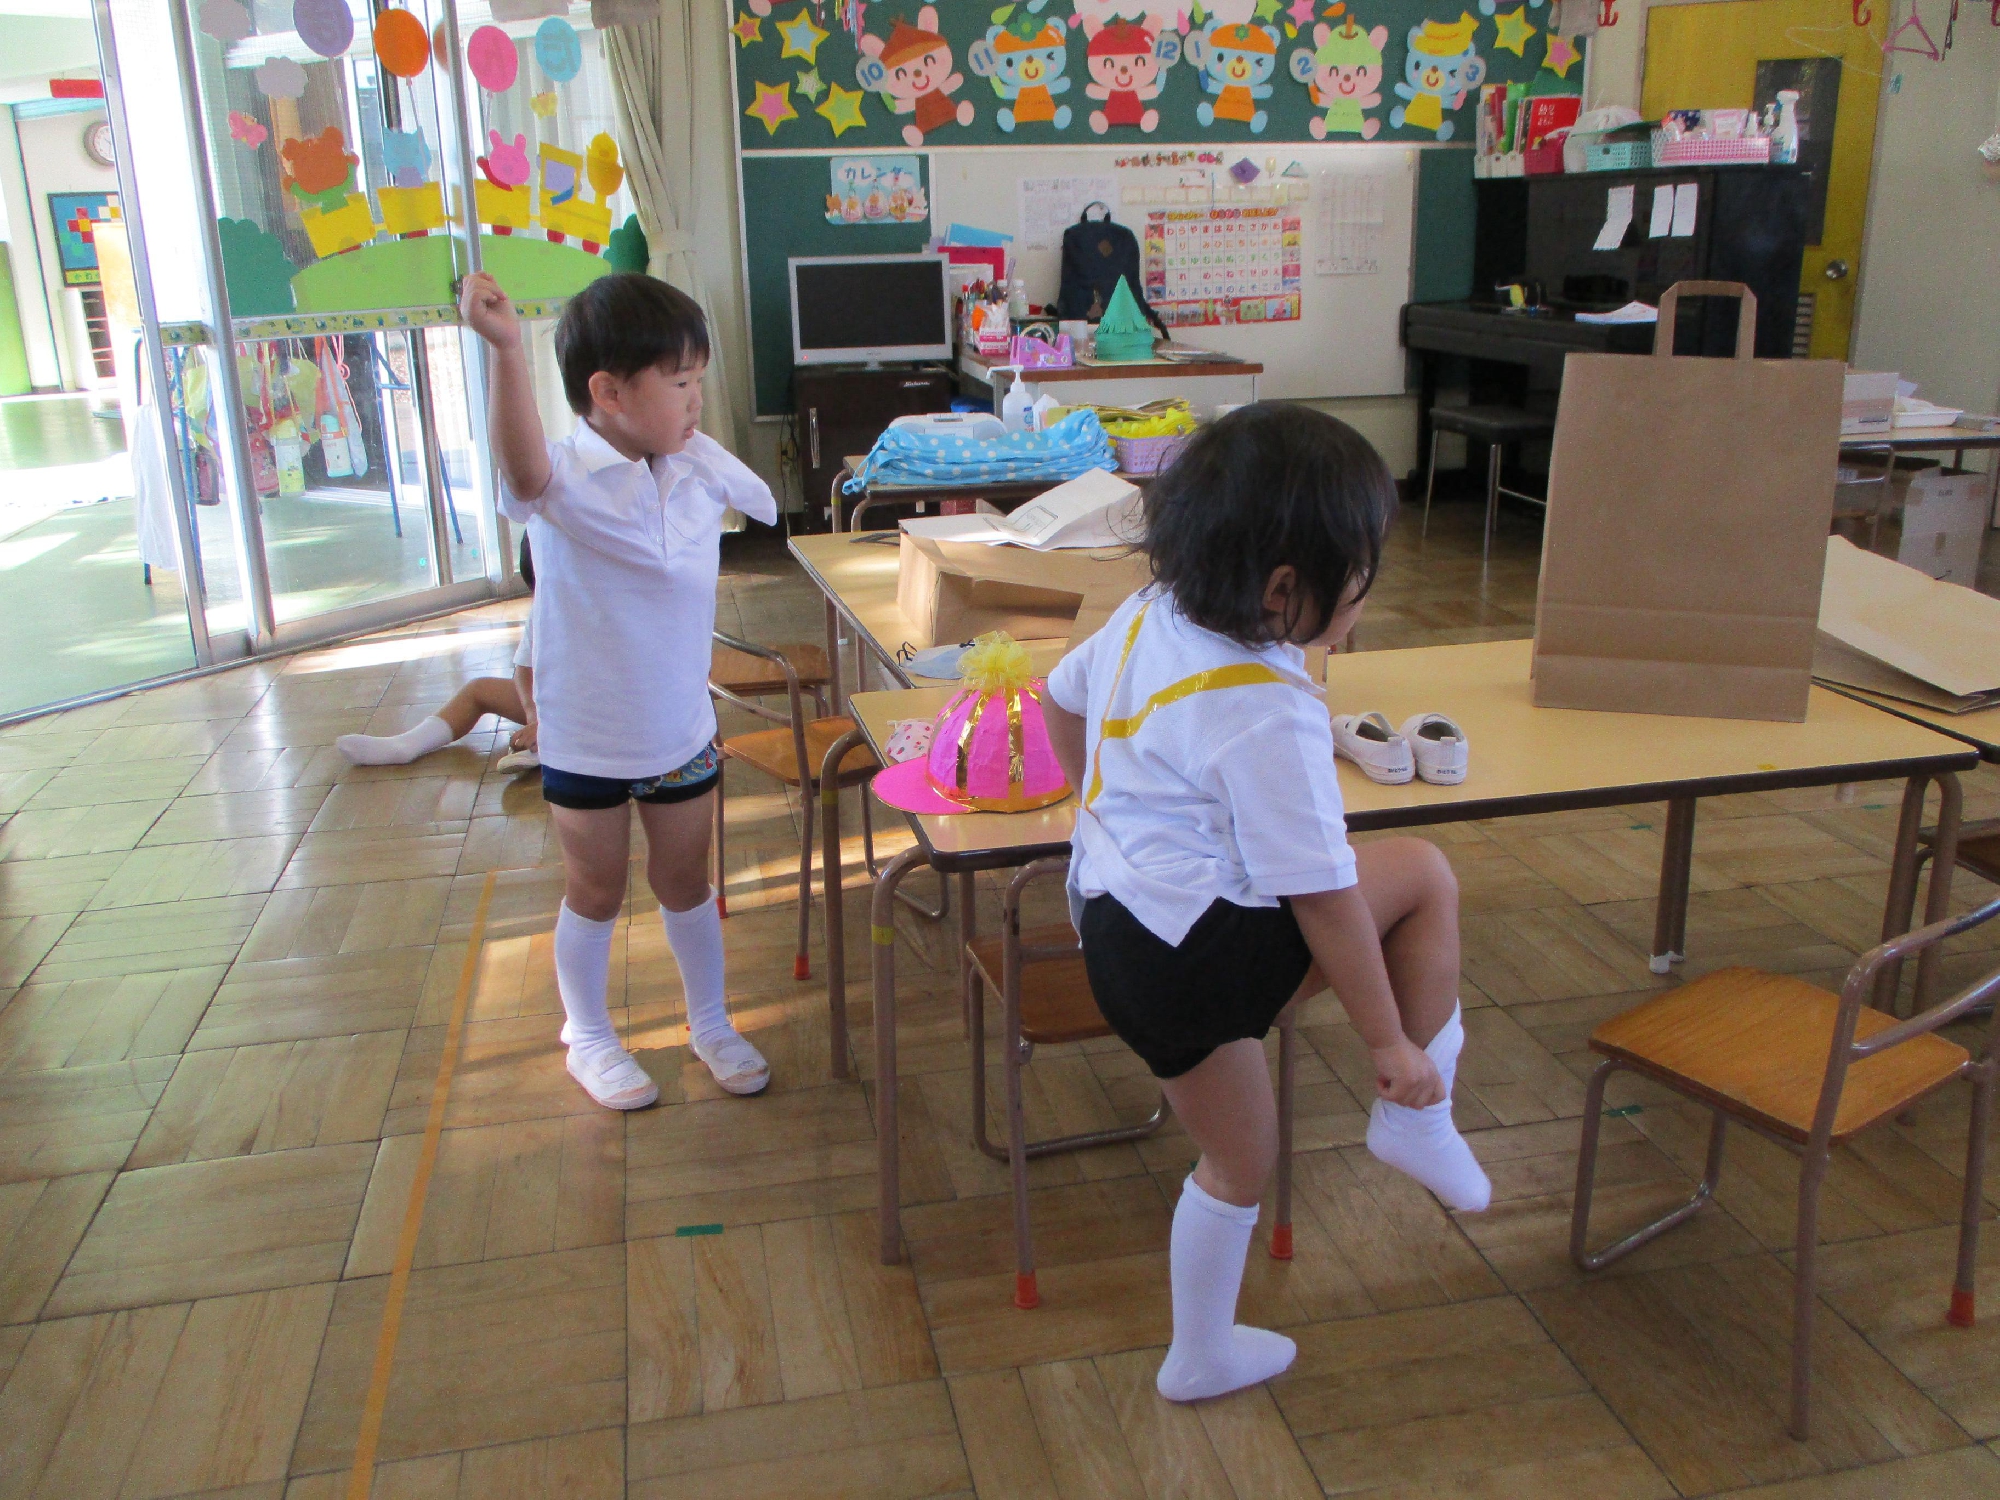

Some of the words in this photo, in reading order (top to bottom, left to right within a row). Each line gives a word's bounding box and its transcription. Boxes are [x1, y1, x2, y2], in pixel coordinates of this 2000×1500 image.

[1156, 41, 1178, 59] 12
[1194, 41, 1201, 57] 1
[974, 48, 994, 69] 11
[1297, 57, 1313, 76] 2
[862, 64, 884, 86] 10
[1465, 64, 1481, 82] 3
[845, 166, 912, 180] カレンダー
